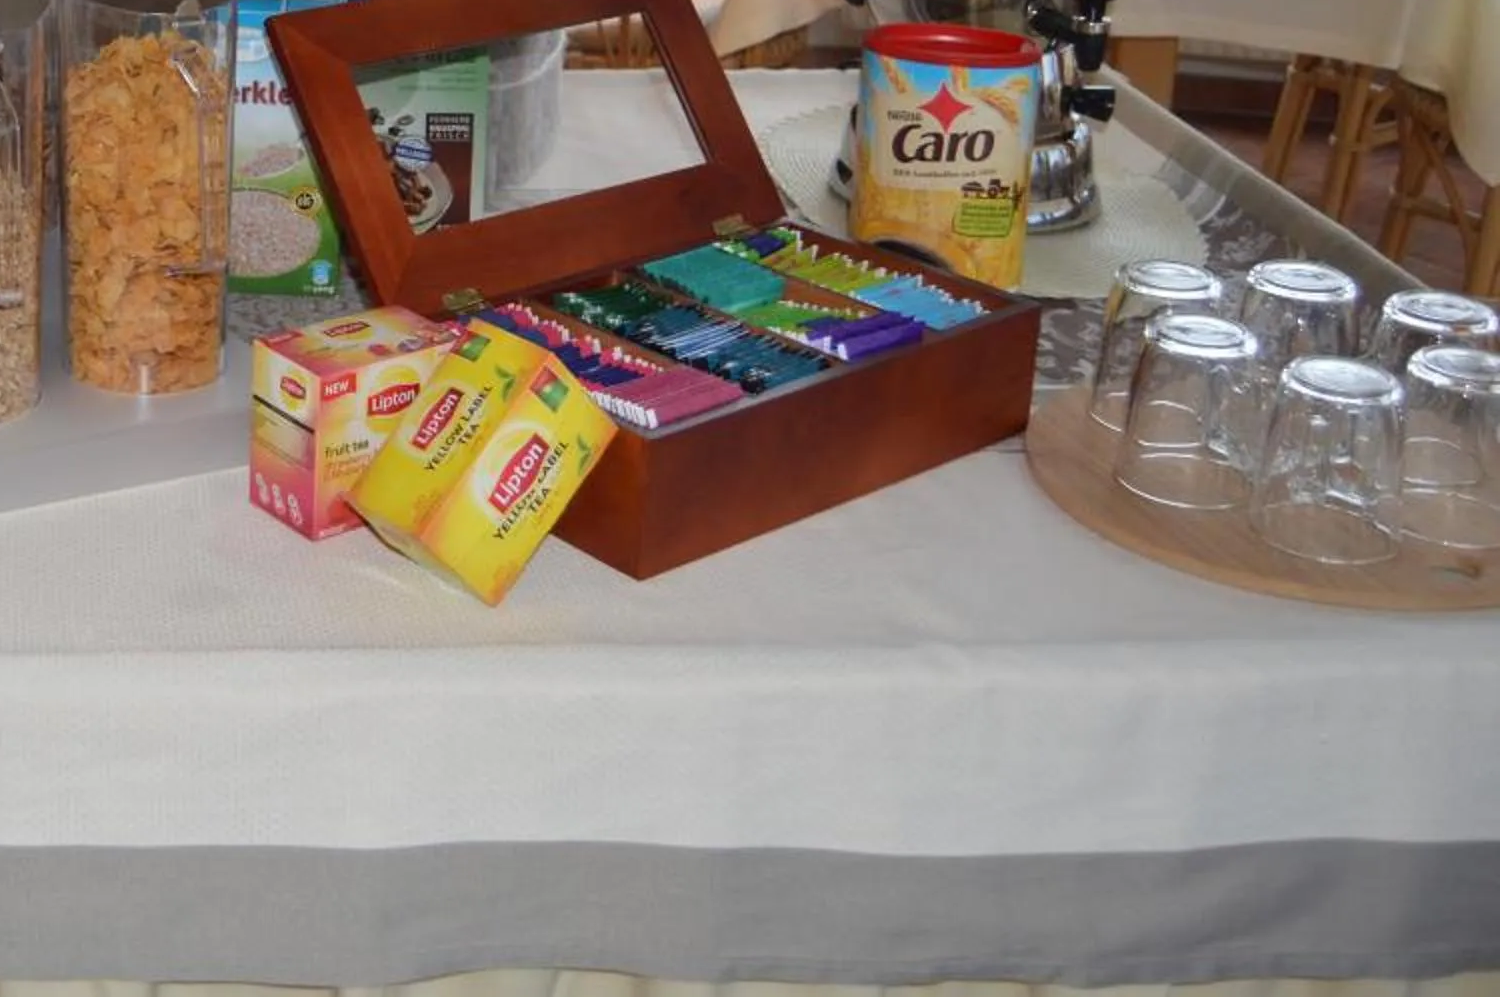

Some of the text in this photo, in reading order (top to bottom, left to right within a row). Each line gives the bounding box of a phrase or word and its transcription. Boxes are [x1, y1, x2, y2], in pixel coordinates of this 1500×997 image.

[892, 123, 995, 163] Caro
[323, 380, 350, 396] NEW
[372, 387, 416, 412] Lipton
[416, 394, 459, 444] Lipton
[425, 385, 493, 471] YELLOW LABEL
[458, 423, 480, 445] TEA
[493, 441, 569, 540] YELLOW LABEL
[495, 443, 544, 505] Lipton
[528, 487, 551, 513] TEA
